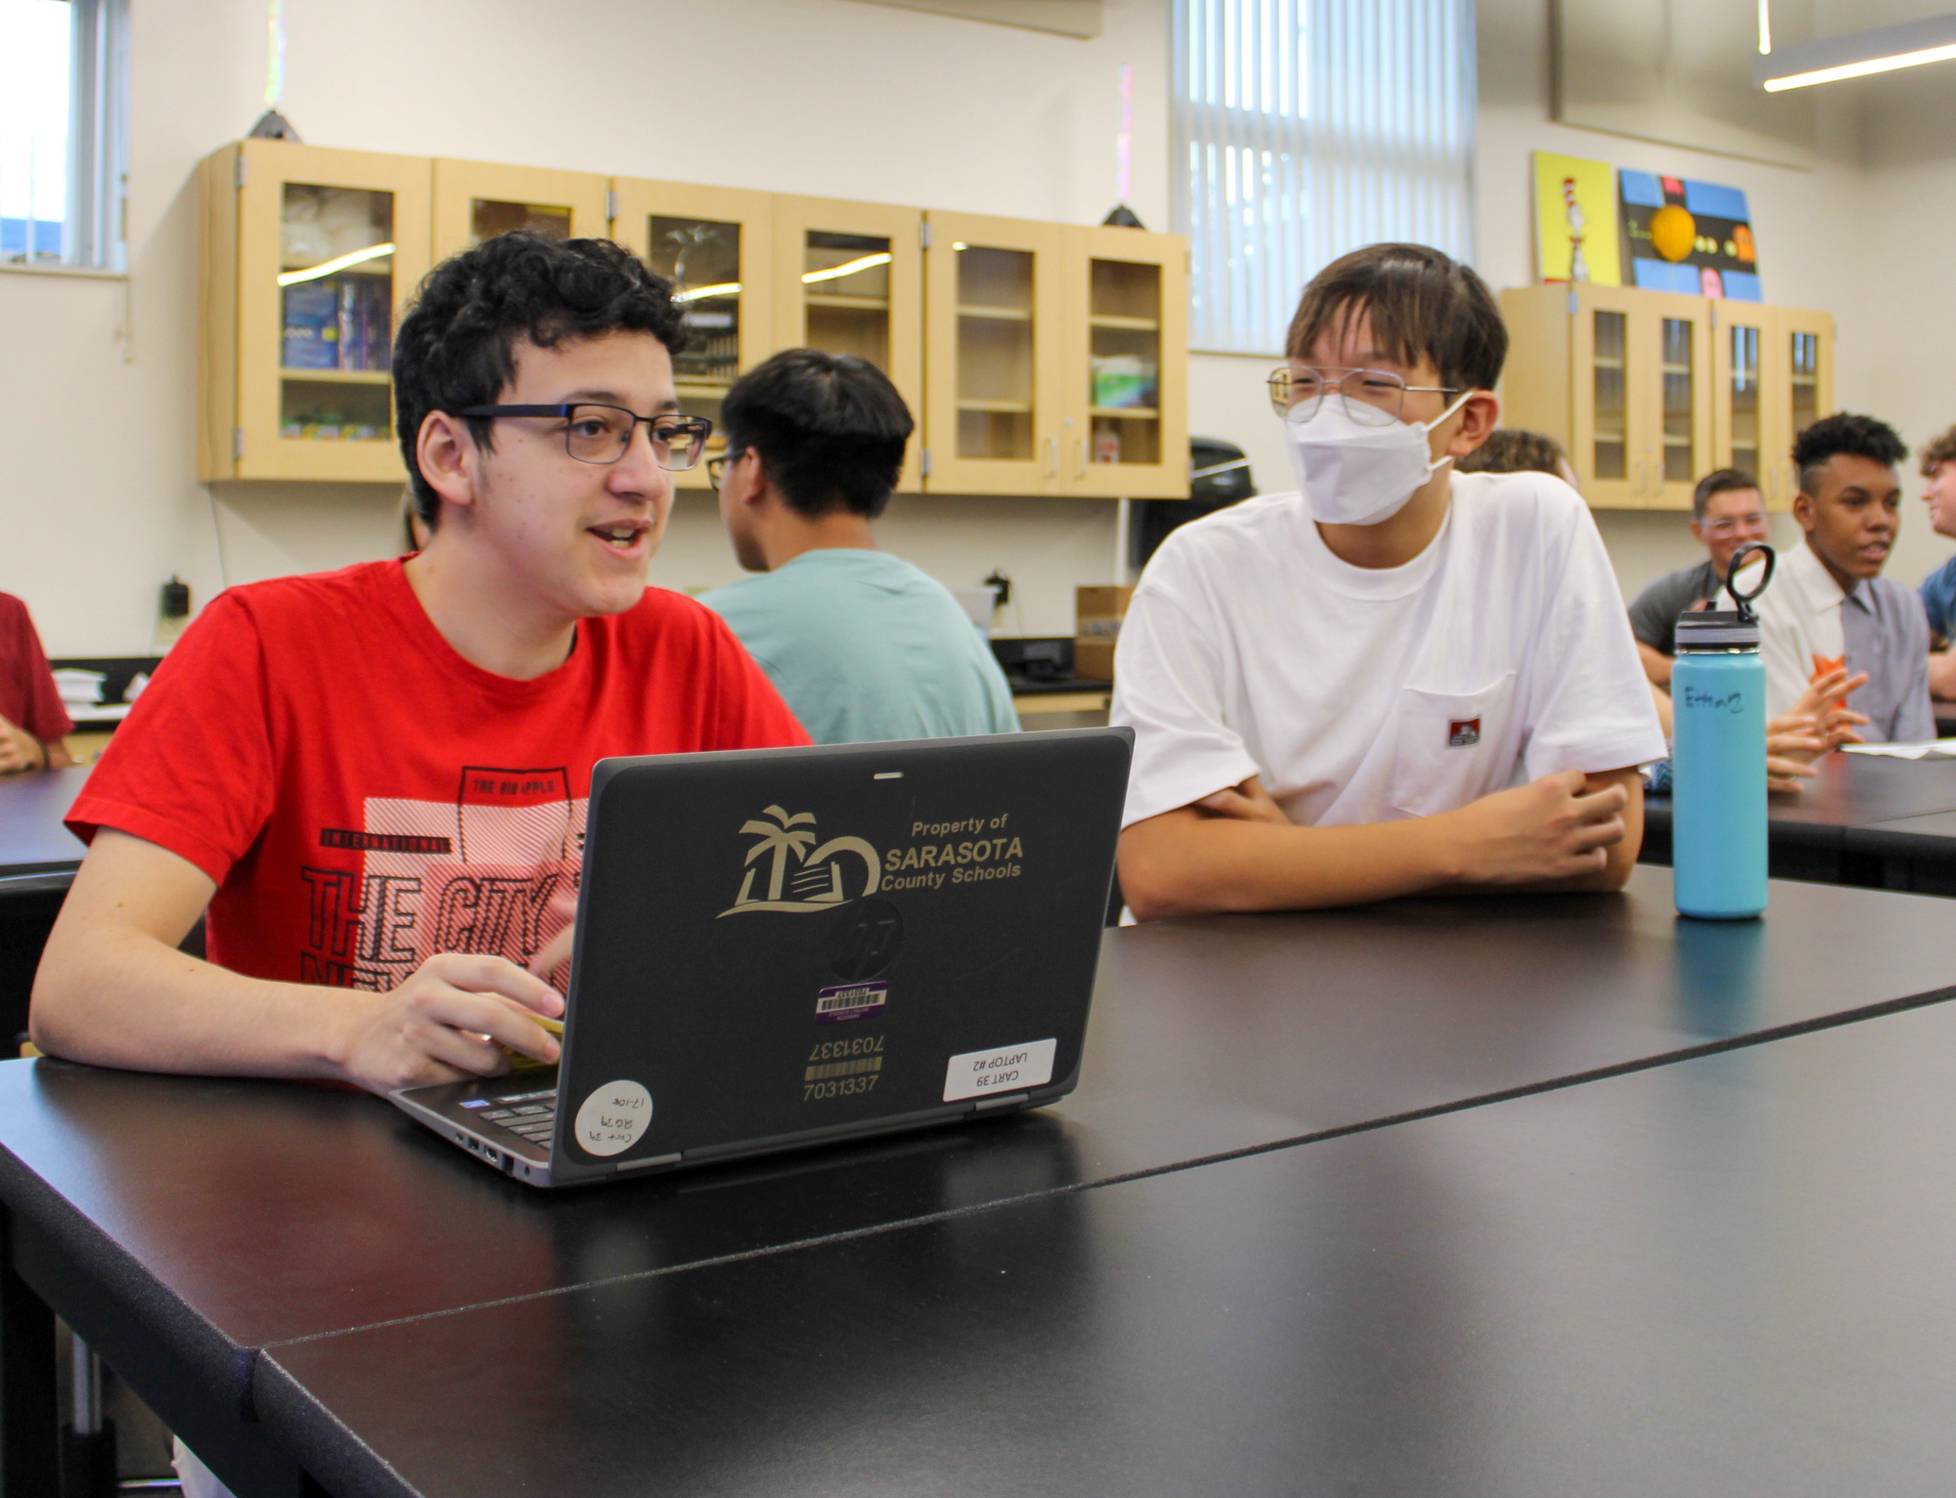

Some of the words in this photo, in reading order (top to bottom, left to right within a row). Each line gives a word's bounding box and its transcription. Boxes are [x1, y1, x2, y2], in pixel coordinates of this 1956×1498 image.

[911, 817, 985, 838] Property
[990, 812, 1009, 829] of
[884, 836, 1024, 872] SARASOTA
[881, 872, 946, 892] County
[951, 862, 1022, 884] Schools
[301, 865, 421, 963] THE
[434, 873, 560, 956] CITY
[809, 1035, 884, 1060] 7031337
[973, 1060, 987, 1072] #2
[989, 1052, 1028, 1069] LAPTOP
[803, 1075, 879, 1101] 7031337
[976, 1075, 990, 1087] 39
[992, 1070, 1019, 1085] CART
